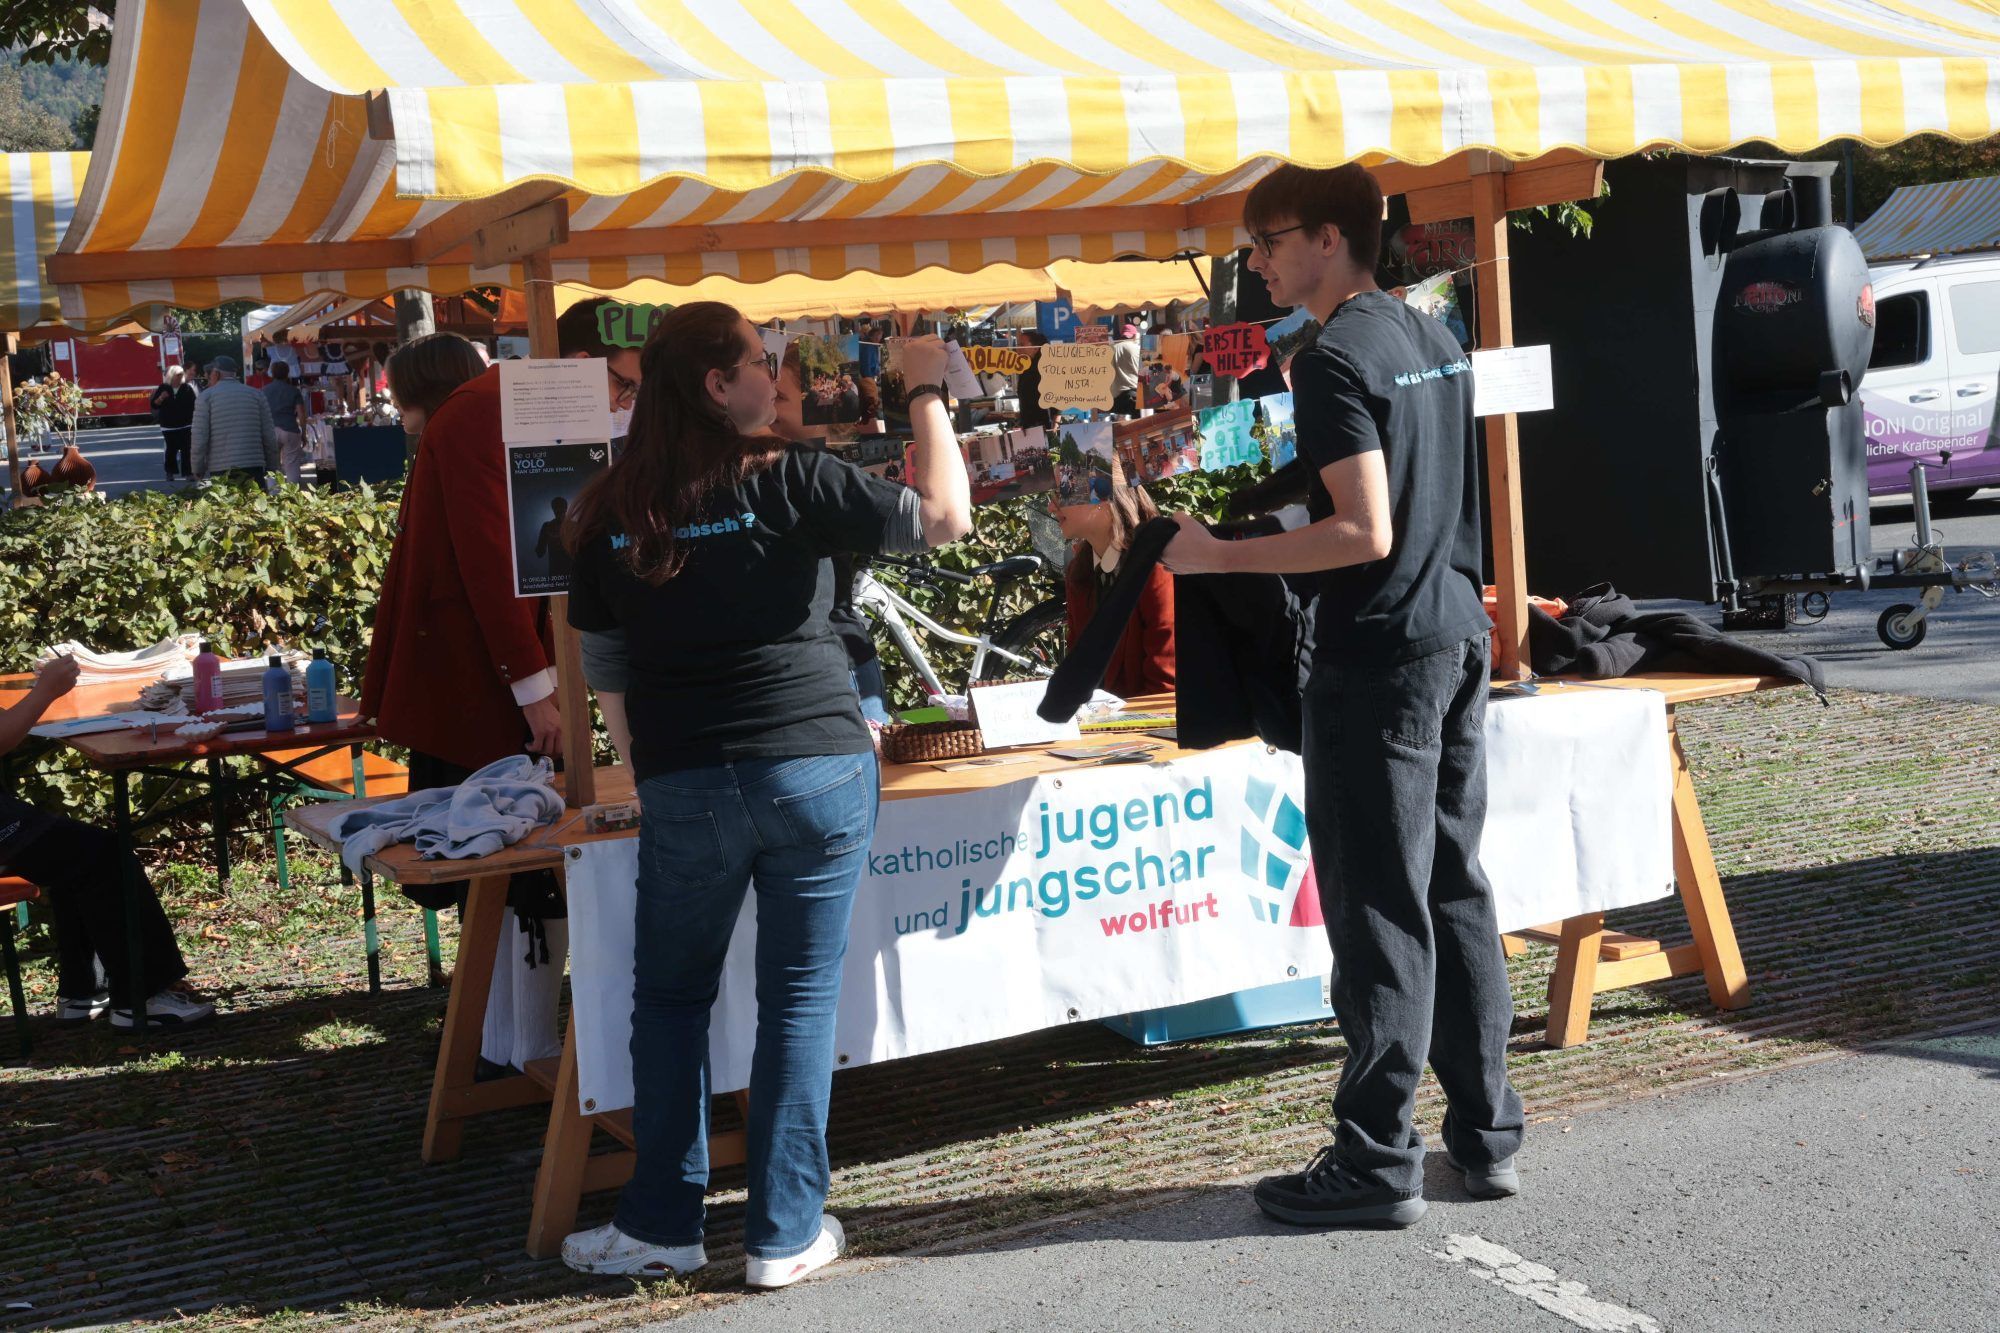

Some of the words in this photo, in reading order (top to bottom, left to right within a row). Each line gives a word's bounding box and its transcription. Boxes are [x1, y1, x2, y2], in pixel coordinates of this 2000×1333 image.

[1054, 307, 1070, 330] P
[1048, 345, 1107, 358] NEUGIERIG?
[1204, 328, 1253, 352] ERSTE
[965, 348, 1029, 372] KOLAUS
[1070, 365, 1087, 375] UNS
[1216, 350, 1262, 371] HILFE
[1201, 401, 1253, 430] BEST
[1912, 408, 1982, 434] Original
[1867, 443, 1900, 457] licher
[1902, 434, 1978, 453] Kraftspender
[514, 458, 545, 469] YOLO
[867, 828, 1029, 877] katholische
[1035, 776, 1214, 860] jugend
[893, 901, 949, 937] und
[955, 845, 1216, 936] jungschar
[1099, 892, 1219, 937] wolfurt
